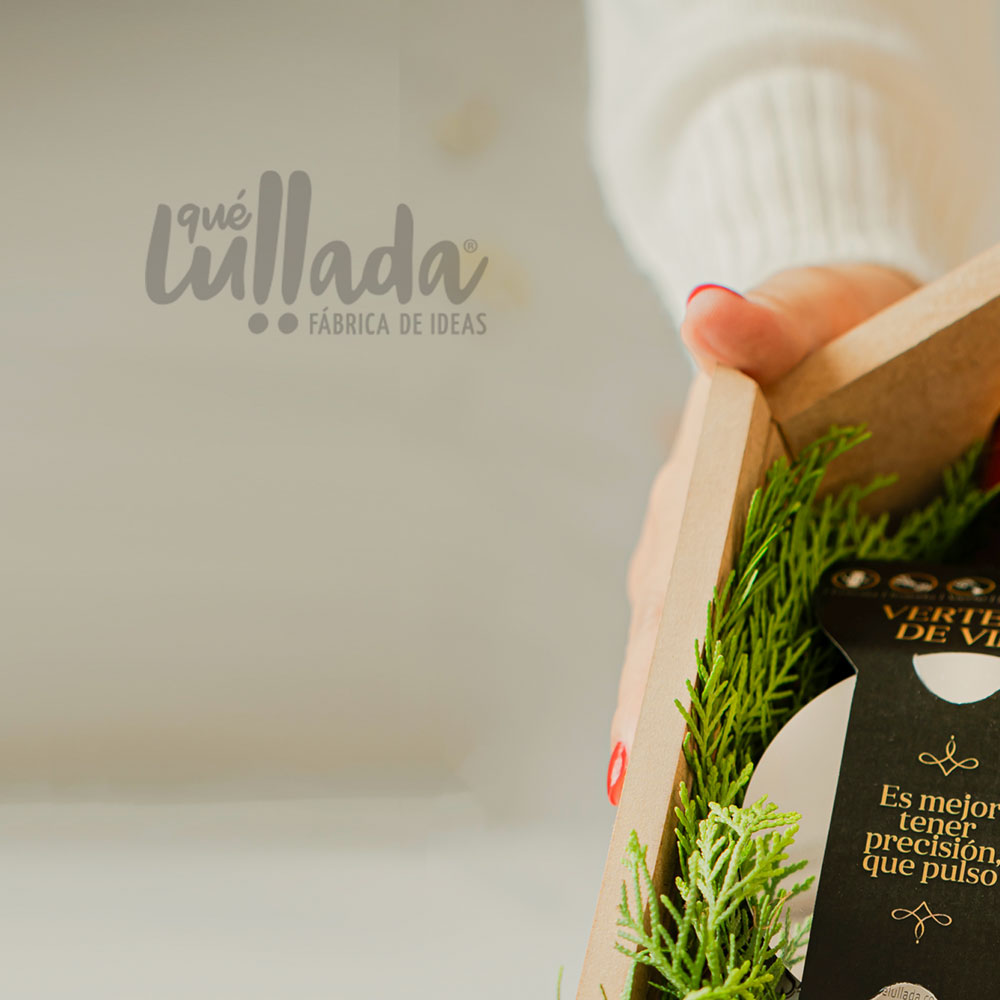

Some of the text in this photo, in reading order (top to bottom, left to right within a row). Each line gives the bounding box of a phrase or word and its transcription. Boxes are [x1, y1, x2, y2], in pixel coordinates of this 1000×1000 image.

[895, 623, 951, 643] DE
[880, 784, 912, 809] Es
[899, 811, 976, 838] tener
[863, 831, 1000, 867] precisión,
[862, 854, 998, 887] que pulso
